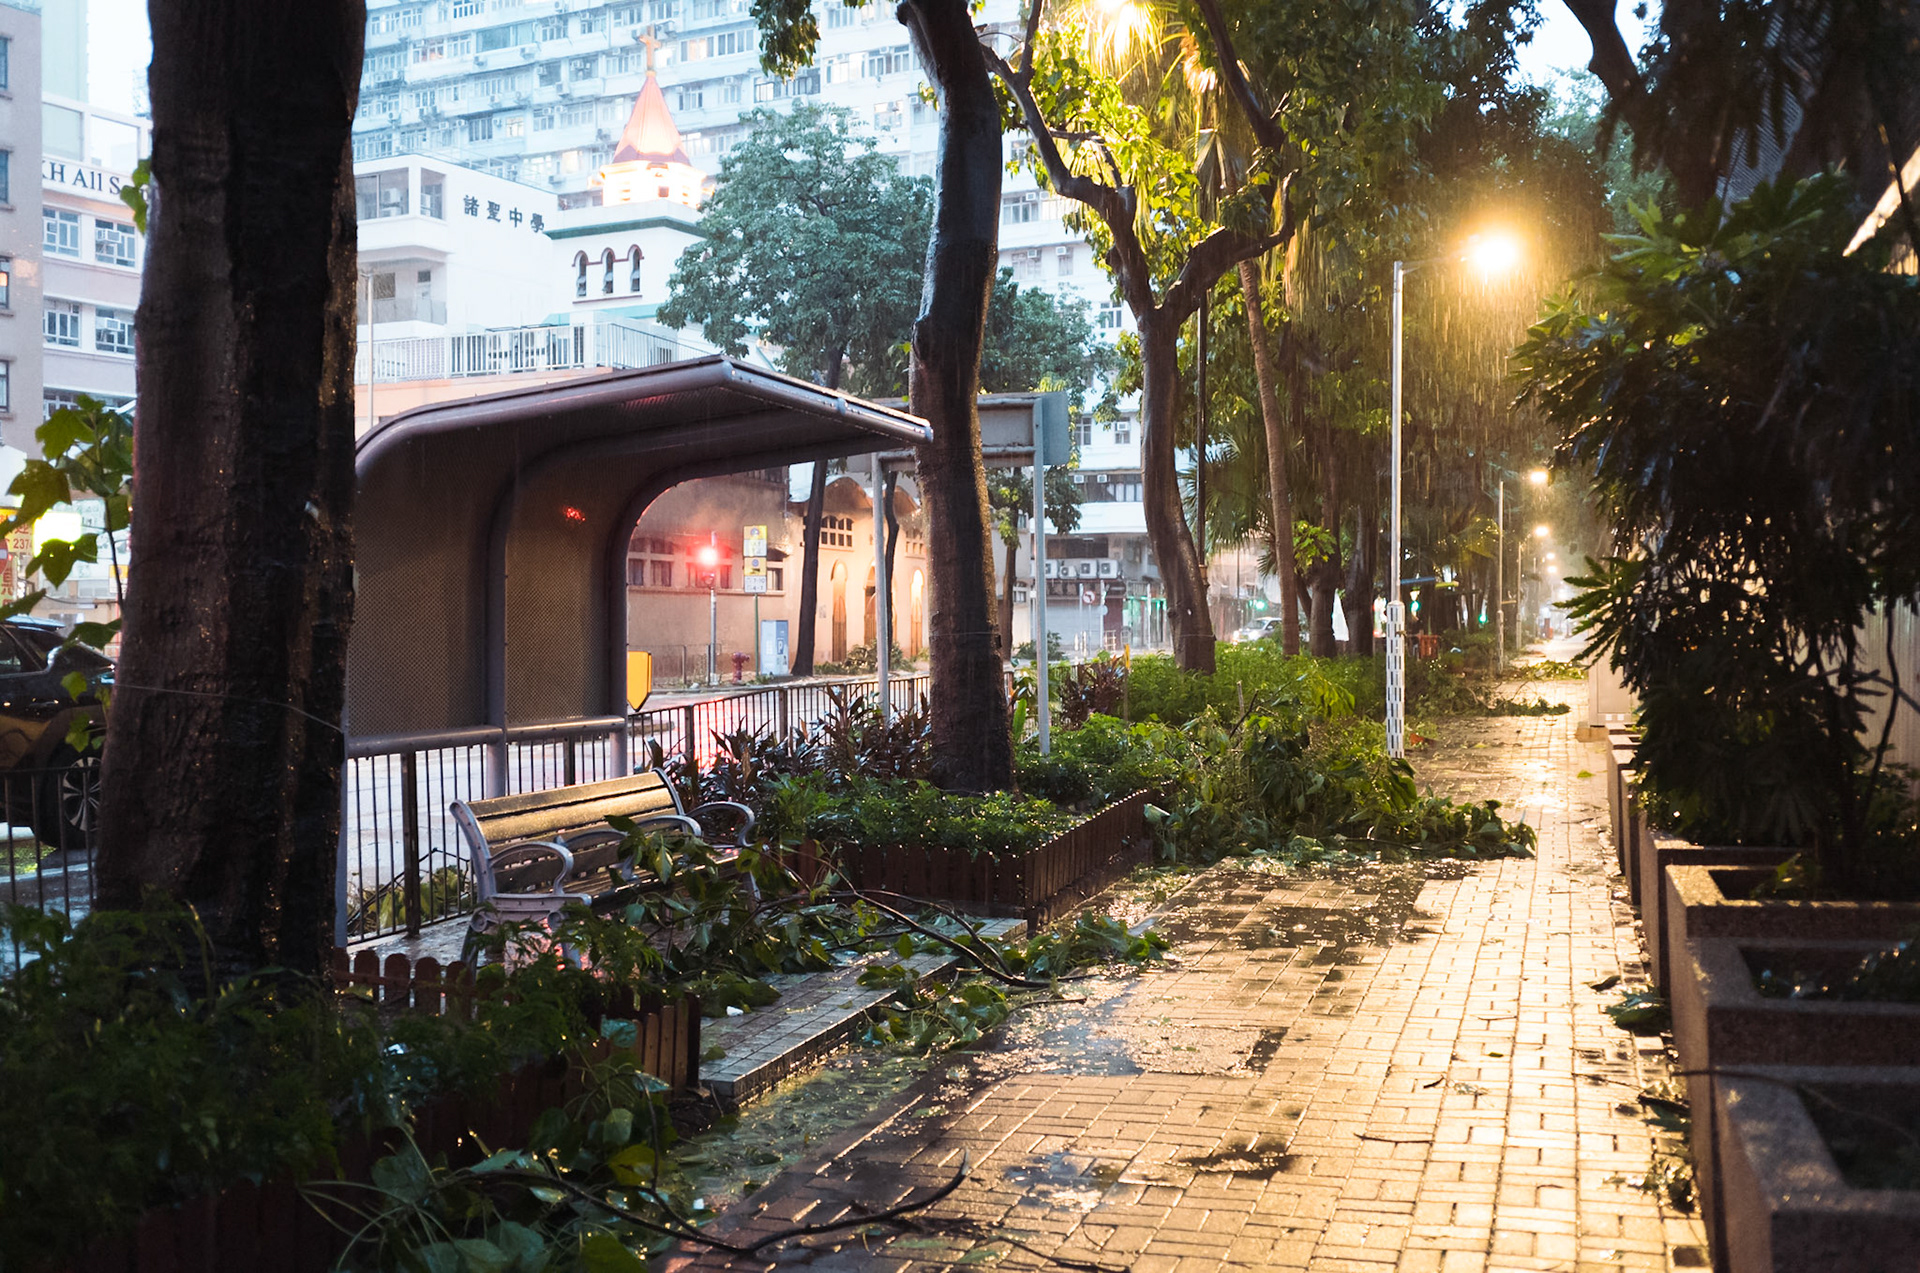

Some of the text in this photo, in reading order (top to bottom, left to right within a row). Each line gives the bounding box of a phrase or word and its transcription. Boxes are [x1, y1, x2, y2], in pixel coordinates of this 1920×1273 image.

[72, 168, 102, 192] All
[463, 194, 545, 233] 諸聖中學
